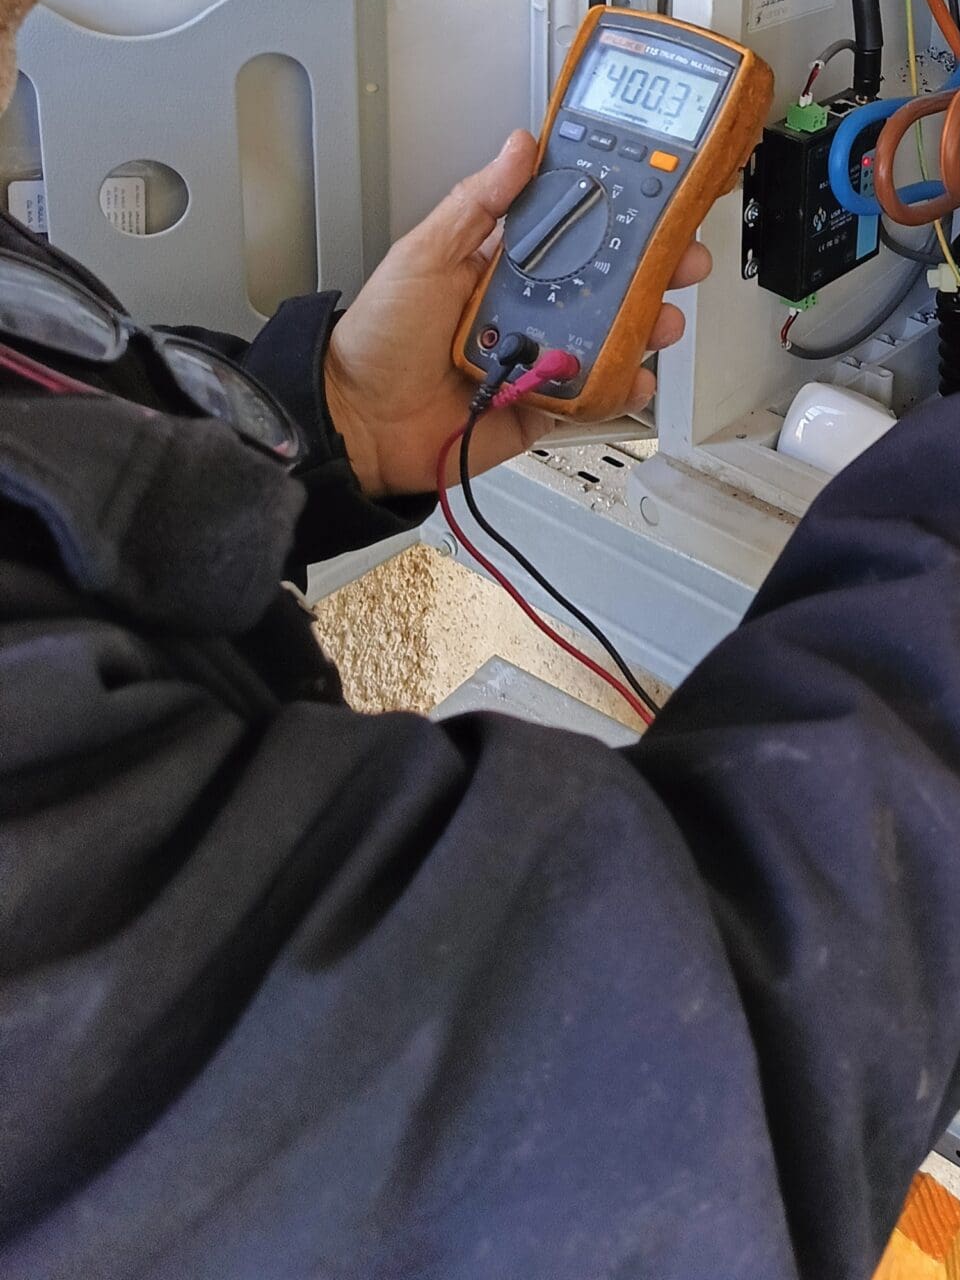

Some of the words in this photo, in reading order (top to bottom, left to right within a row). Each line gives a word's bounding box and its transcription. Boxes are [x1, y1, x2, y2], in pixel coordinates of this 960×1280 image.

[645, 47, 659, 56] 115
[607, 64, 691, 118] 400.3
[576, 159, 592, 168] OFF
